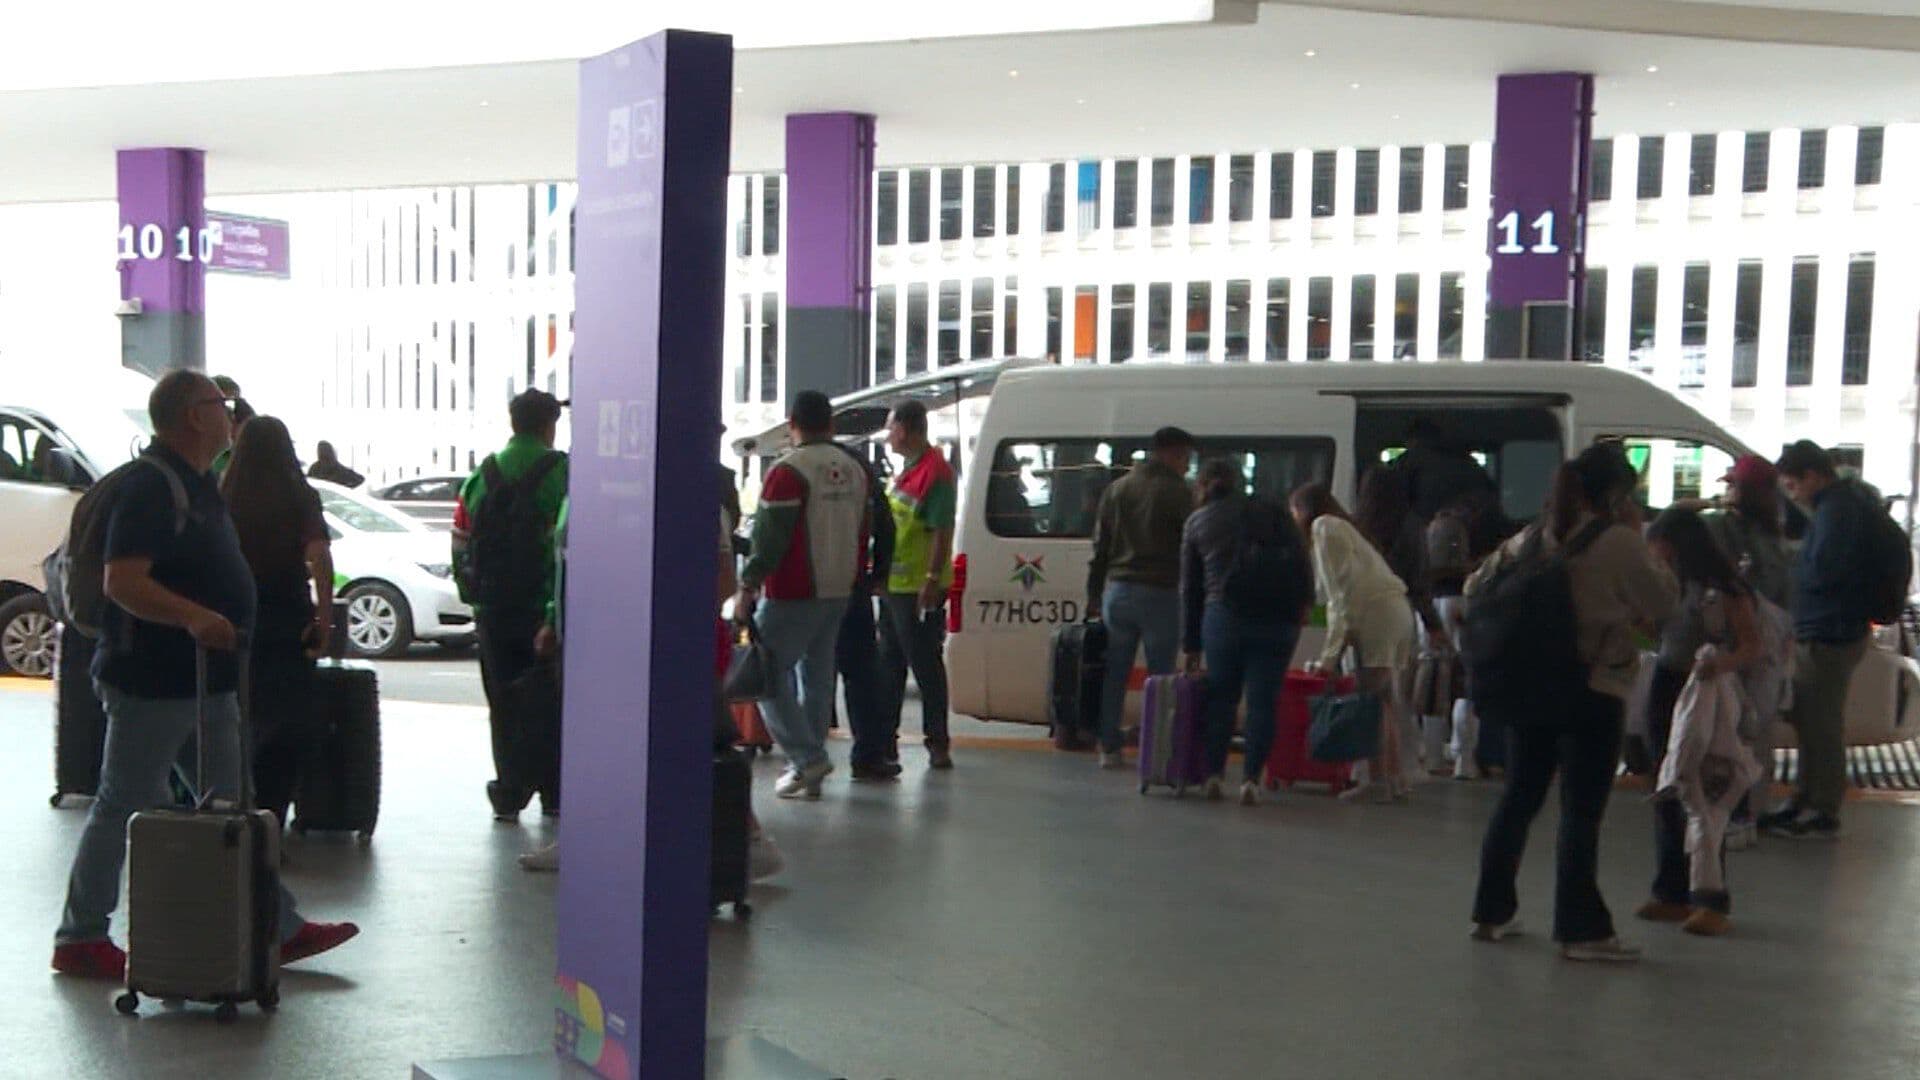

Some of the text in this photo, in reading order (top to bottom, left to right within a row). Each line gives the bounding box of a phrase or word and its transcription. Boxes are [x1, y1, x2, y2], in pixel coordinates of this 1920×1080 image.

[117, 223, 164, 260] 10
[175, 225, 213, 264] 10
[1496, 210, 1560, 254] 11
[977, 599, 1079, 624] 77HC3D
